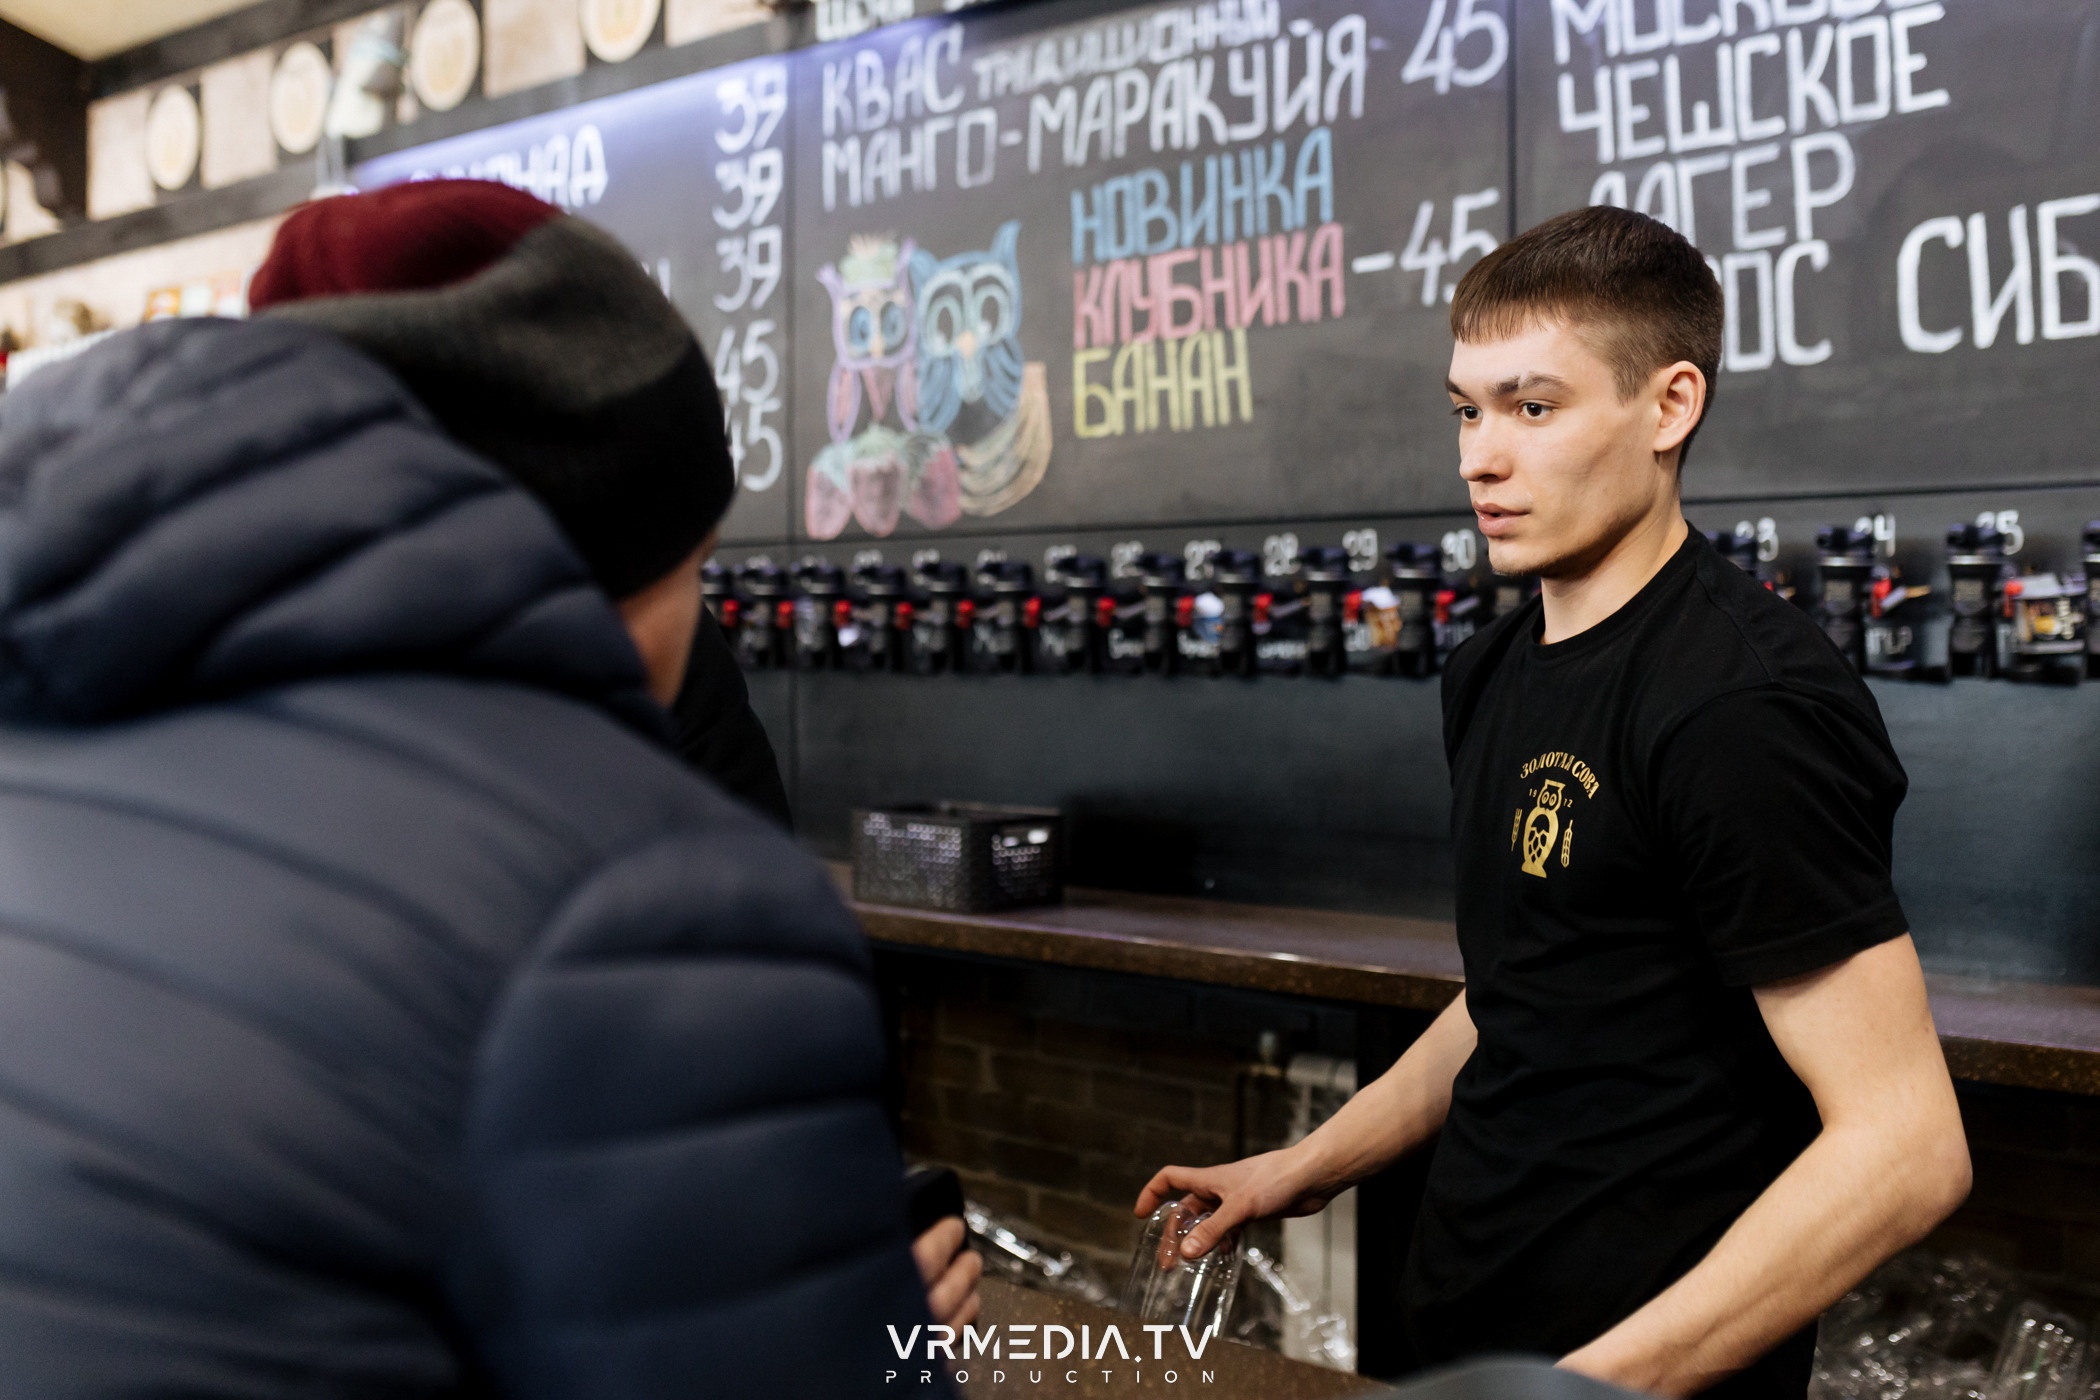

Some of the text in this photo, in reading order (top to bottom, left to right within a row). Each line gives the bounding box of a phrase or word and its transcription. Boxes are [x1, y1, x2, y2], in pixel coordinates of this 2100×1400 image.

[822, 23, 966, 134] КВАС
[1401, 0, 1509, 95] 45
[1557, 3, 1950, 164] ЧЕШСКОЕ
[714, 66, 788, 154] 39
[712, 148, 784, 231] 39
[1069, 126, 1335, 265] НОВИНКА
[712, 224, 783, 313] 39
[1072, 222, 1345, 350] КЛУБНИКА
[1897, 193, 2100, 353] СИБ
[714, 319, 780, 405] 45
[1072, 326, 1255, 440] БАНАН
[1563, 798, 1574, 808] 12
[1571, 760, 1600, 800] СОВА
